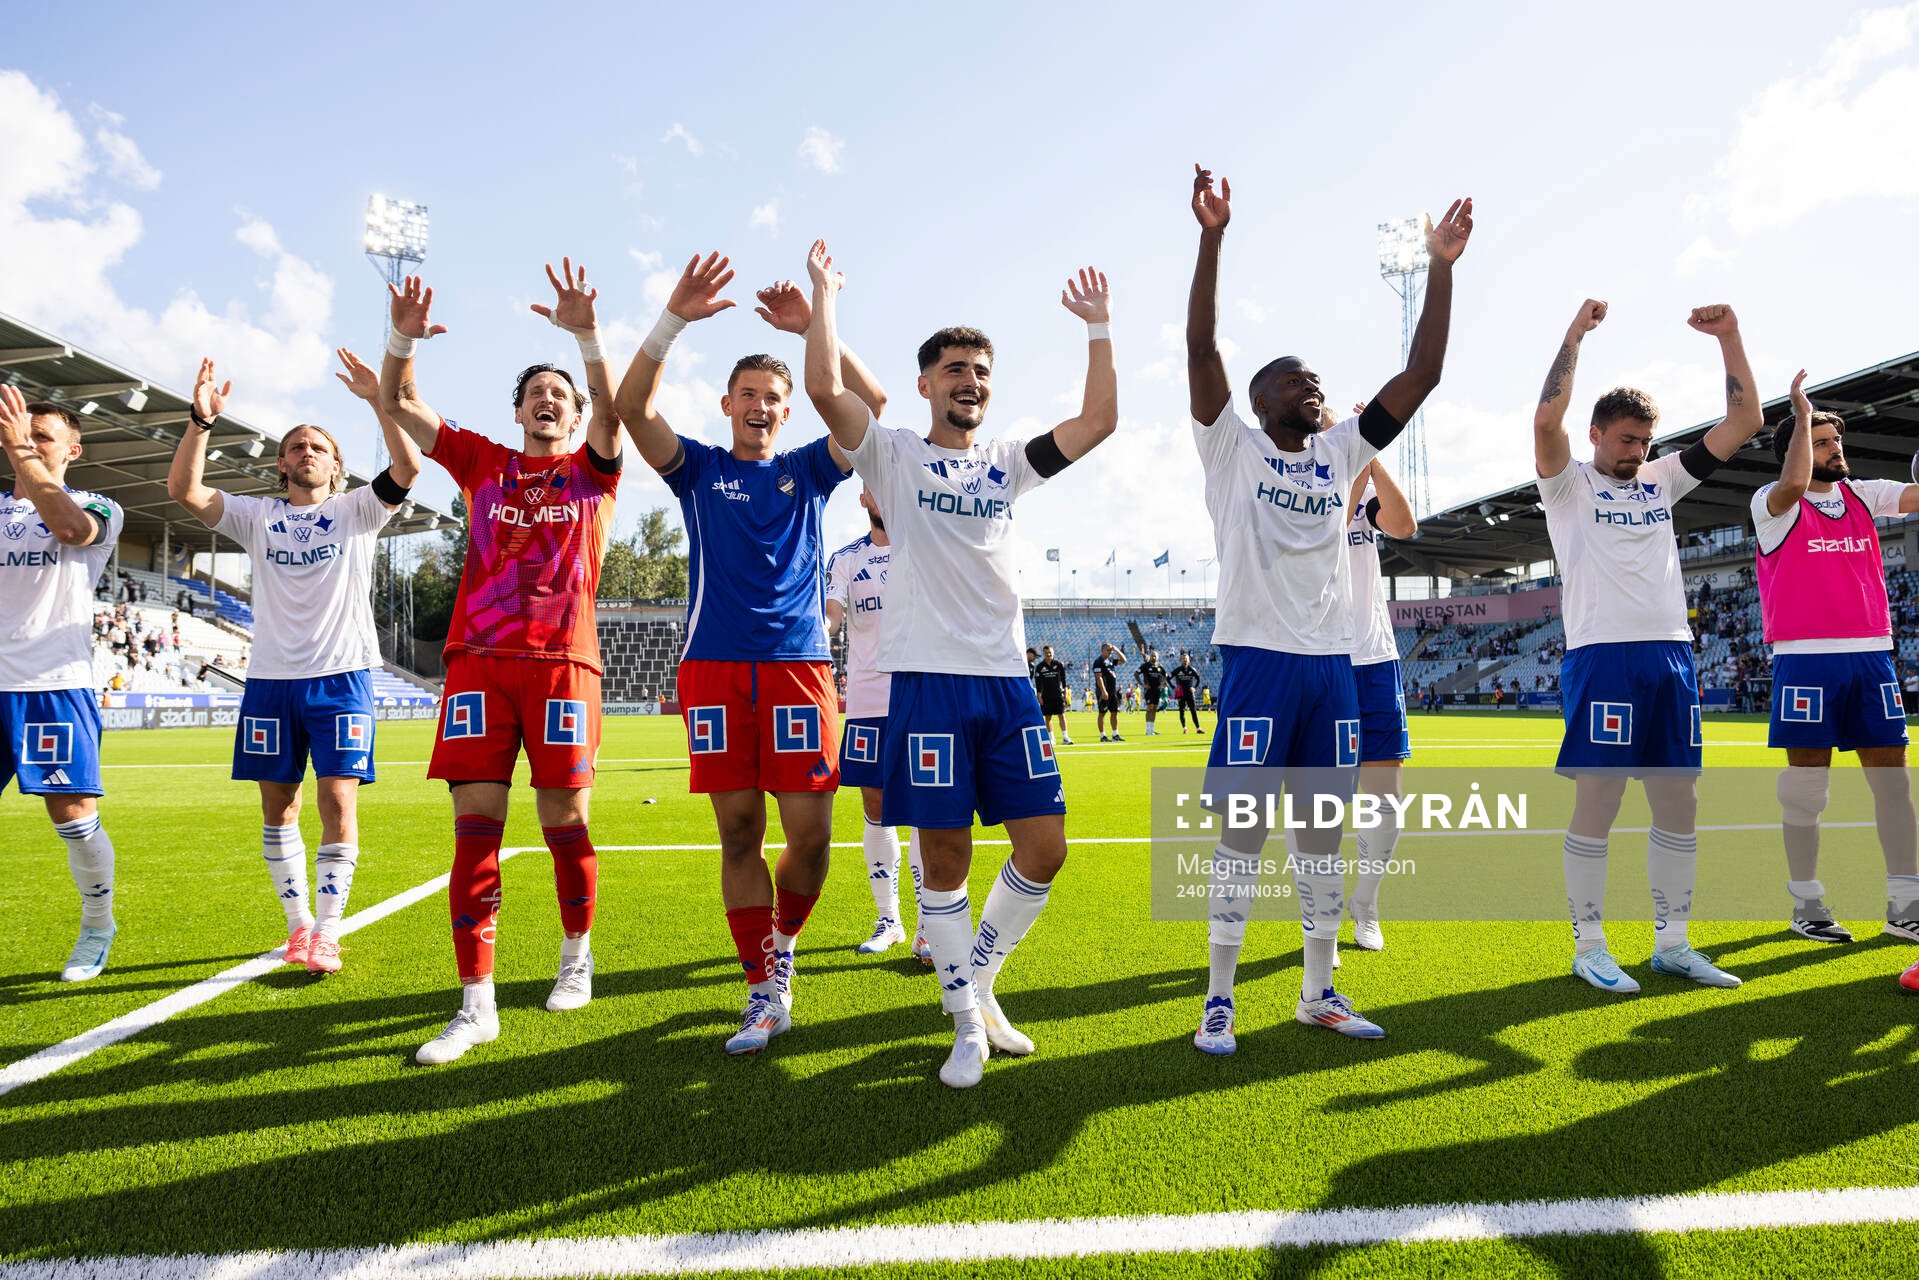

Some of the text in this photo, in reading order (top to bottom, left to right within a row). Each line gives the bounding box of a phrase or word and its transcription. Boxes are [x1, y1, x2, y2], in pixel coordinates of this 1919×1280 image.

[488, 502, 580, 527] HOLMEN
[266, 542, 343, 566] HOLMEN
[868, 554, 890, 565] stad
[855, 596, 883, 613] HOL
[1396, 603, 1486, 620] INNERSTAN
